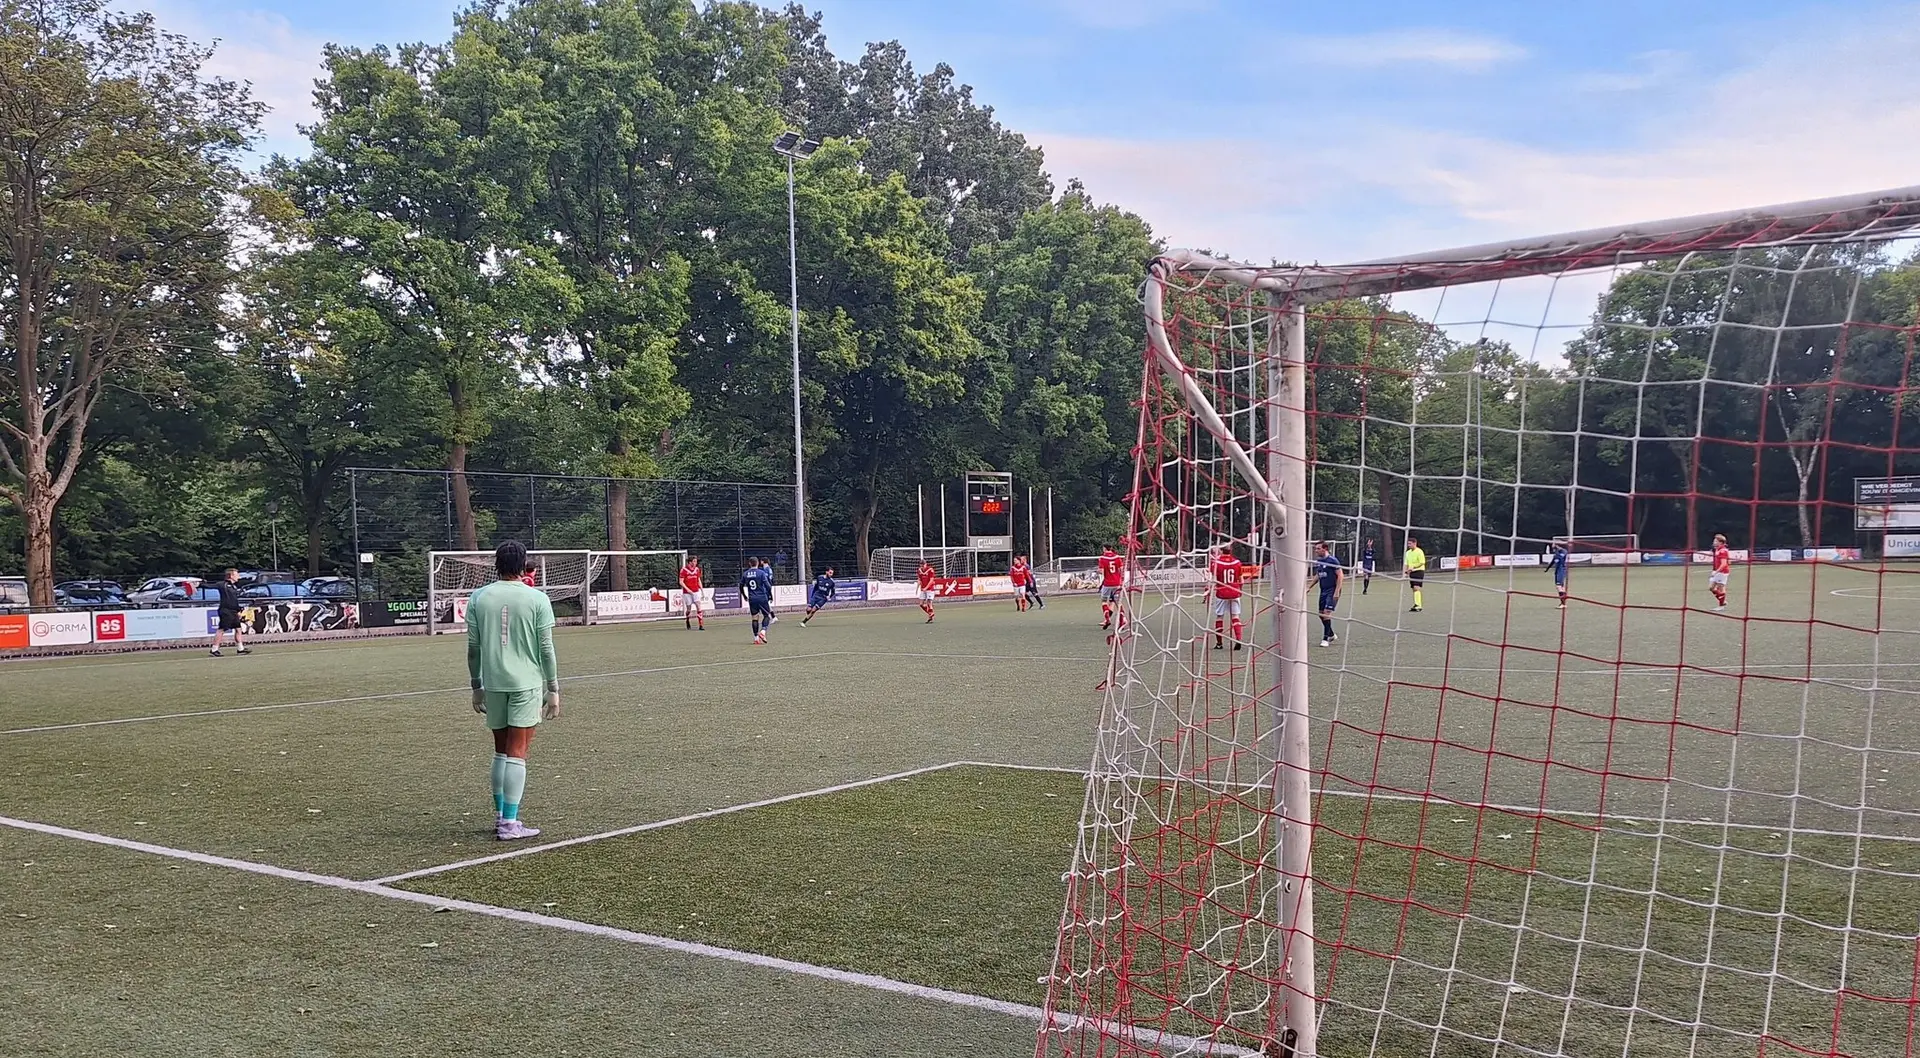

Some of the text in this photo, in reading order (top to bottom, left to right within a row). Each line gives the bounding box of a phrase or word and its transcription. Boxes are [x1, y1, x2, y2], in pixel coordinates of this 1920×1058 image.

[1109, 561, 1116, 573] 5
[1223, 568, 1235, 583] 16
[749, 580, 757, 590] 9
[50, 624, 88, 633] FORMA
[501, 605, 508, 646] 1
